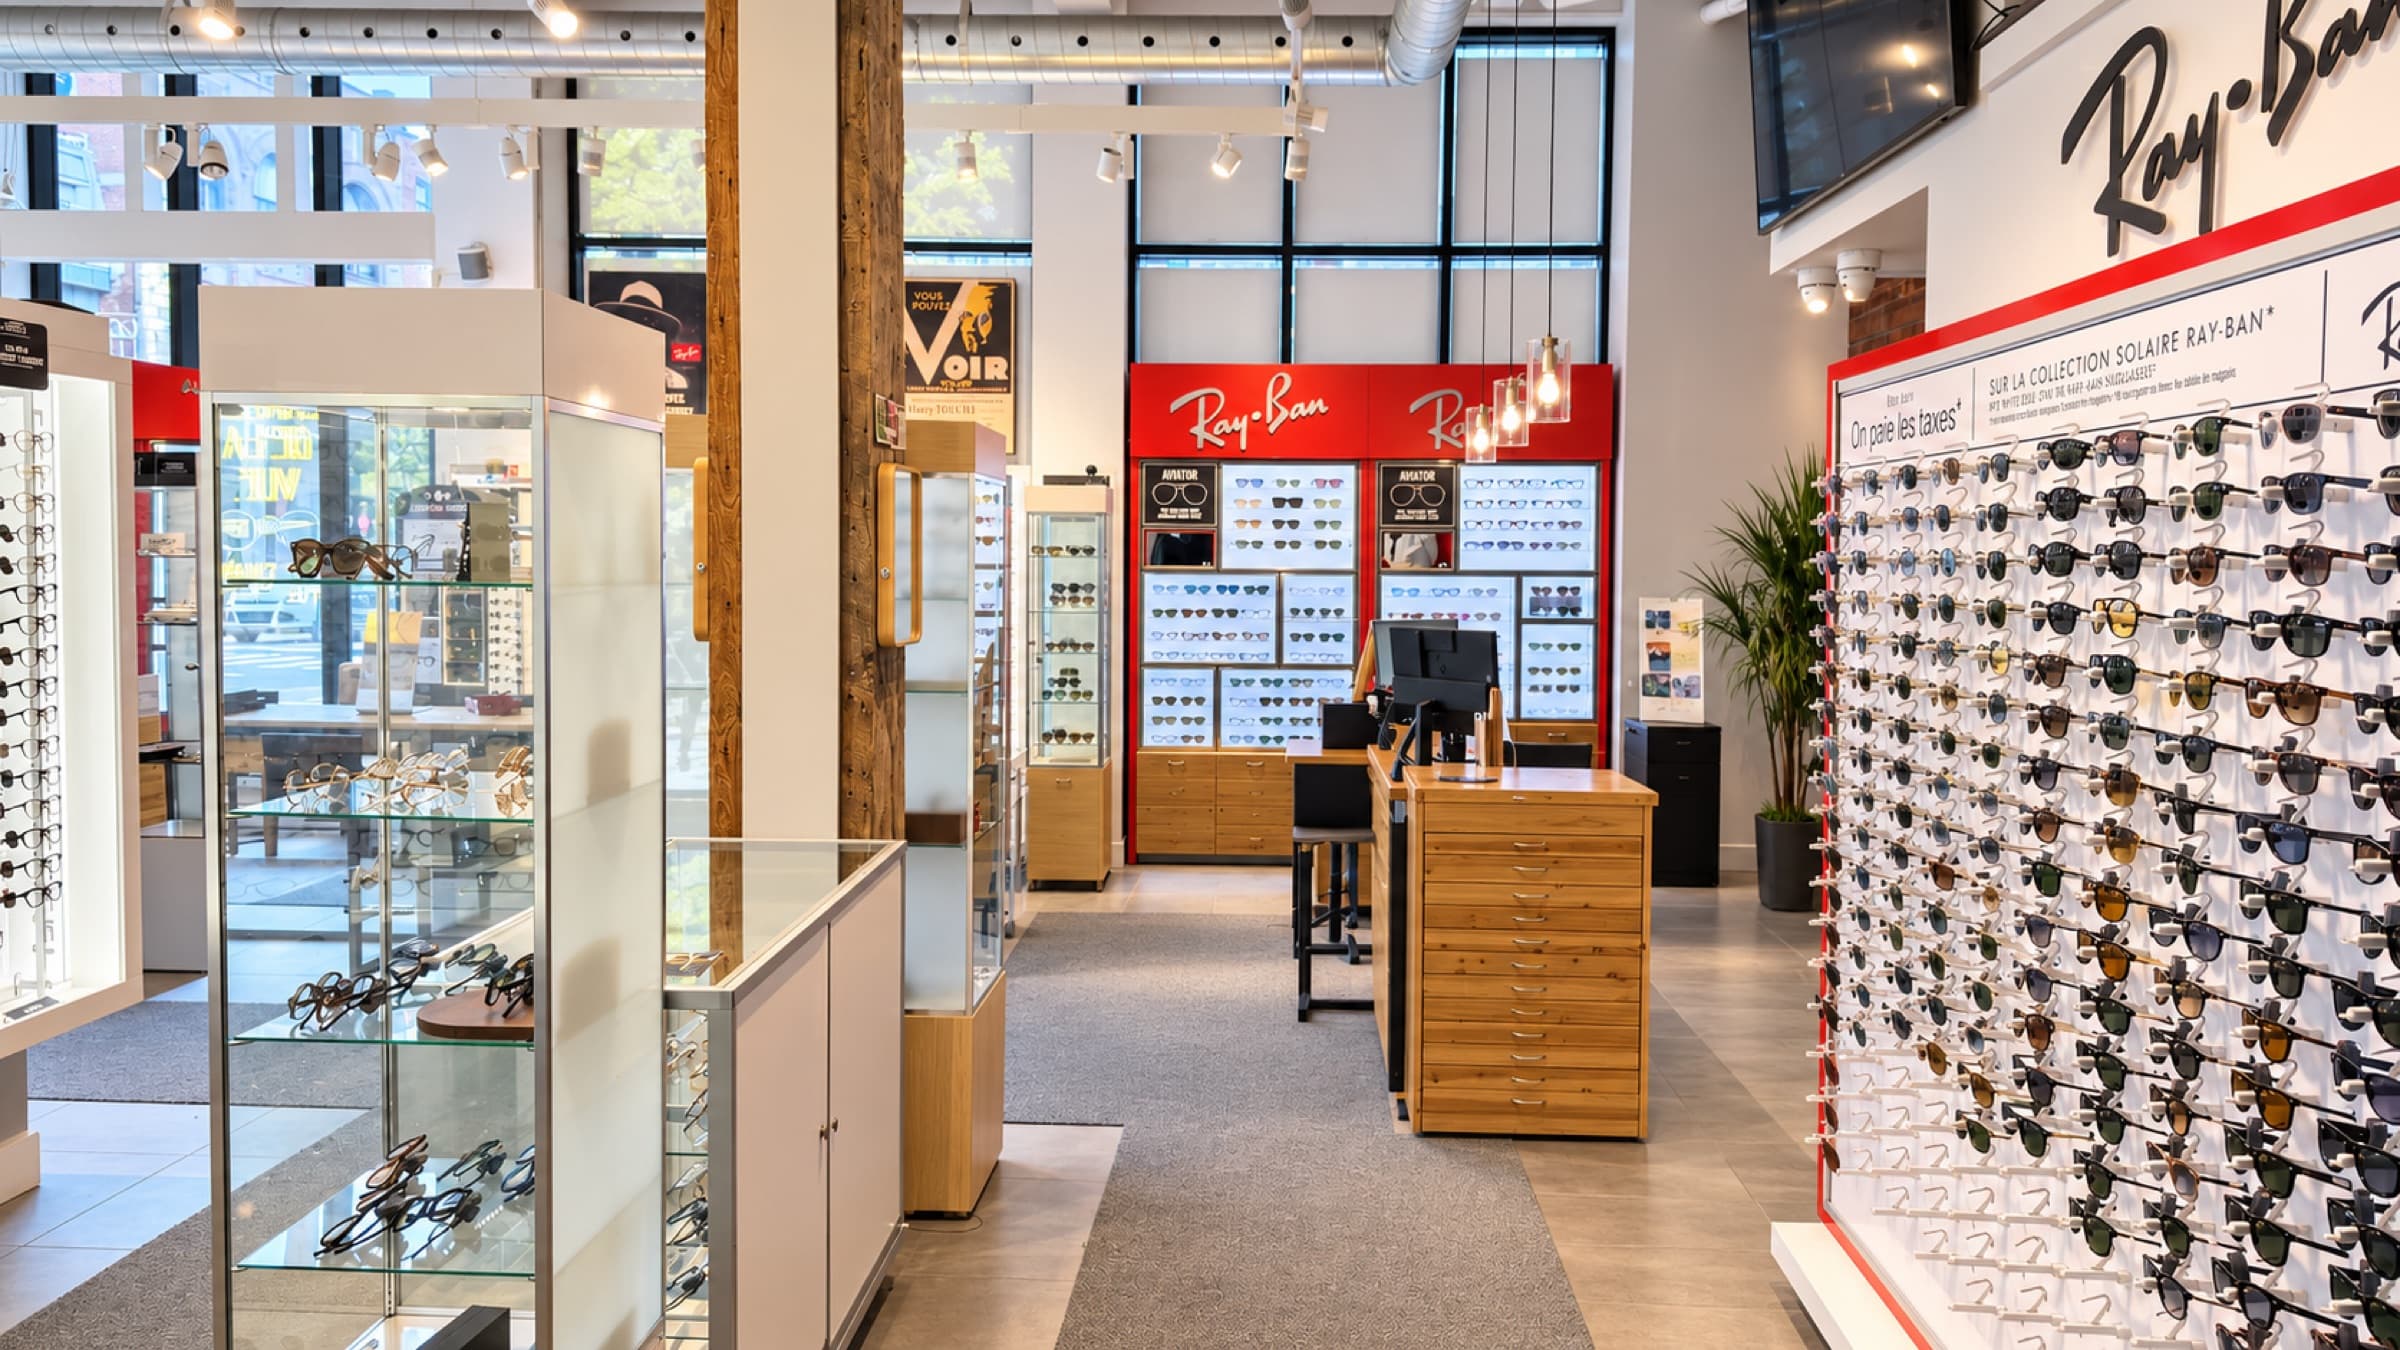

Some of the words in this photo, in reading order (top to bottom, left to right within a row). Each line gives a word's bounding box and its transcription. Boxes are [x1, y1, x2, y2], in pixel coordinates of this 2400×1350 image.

[913, 291, 943, 301] VOUS
[904, 281, 1008, 385] VOIR
[1989, 375, 2009, 396] SUR
[2013, 372, 2026, 391] LA
[2029, 349, 2110, 386] COLLECTION
[2116, 330, 2179, 367] SOLAIRE
[1851, 420, 1867, 449] On
[1869, 415, 1894, 452] paie
[1897, 412, 1915, 440] les
[1162, 468, 1199, 481] AVIATOR
[1399, 469, 1436, 482] AVIATOR
